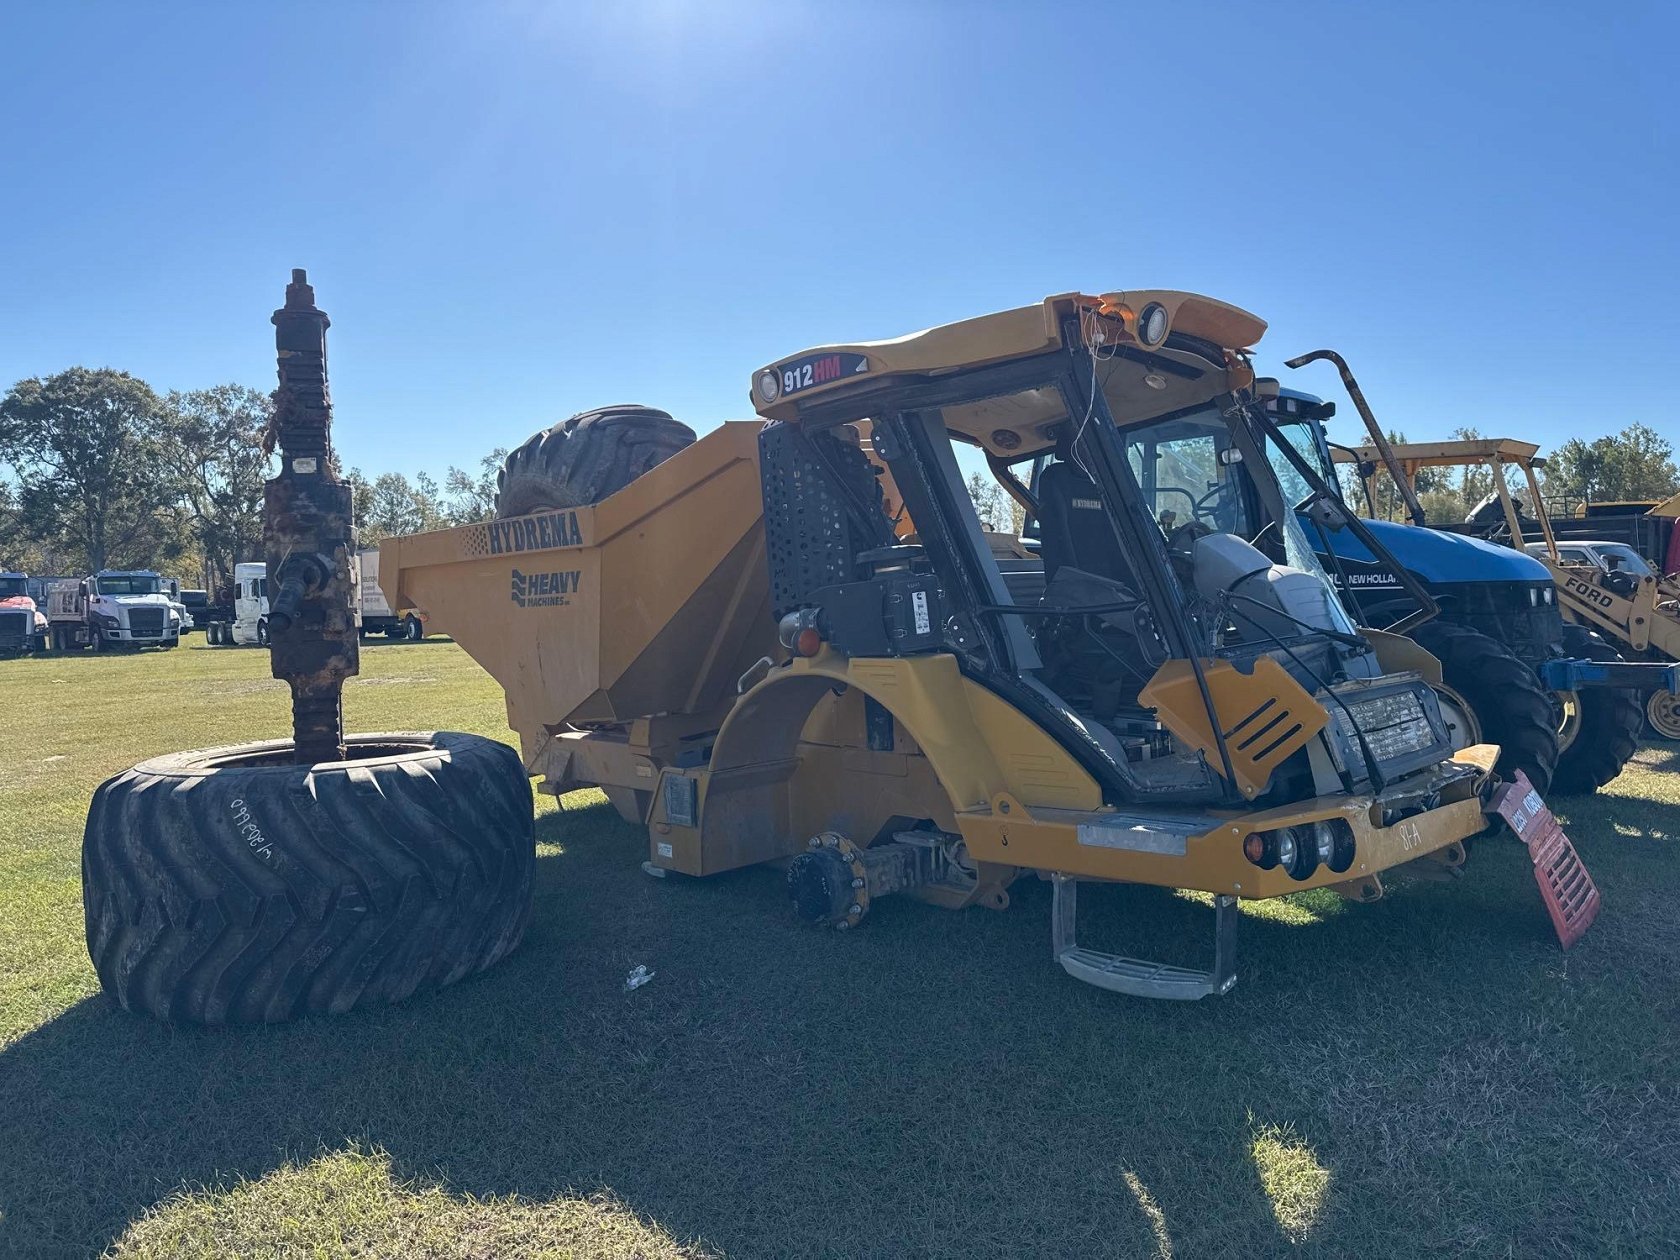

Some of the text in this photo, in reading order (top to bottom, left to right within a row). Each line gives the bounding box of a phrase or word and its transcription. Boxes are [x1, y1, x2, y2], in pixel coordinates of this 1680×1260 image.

[487, 511, 584, 555] HYDREMA
[528, 570, 582, 596] HEAVY
[1348, 574, 1366, 584] NEW
[1366, 573, 1399, 584] HOLLA
[527, 596, 565, 607] MACHINES
[1565, 576, 1613, 608] FORD
